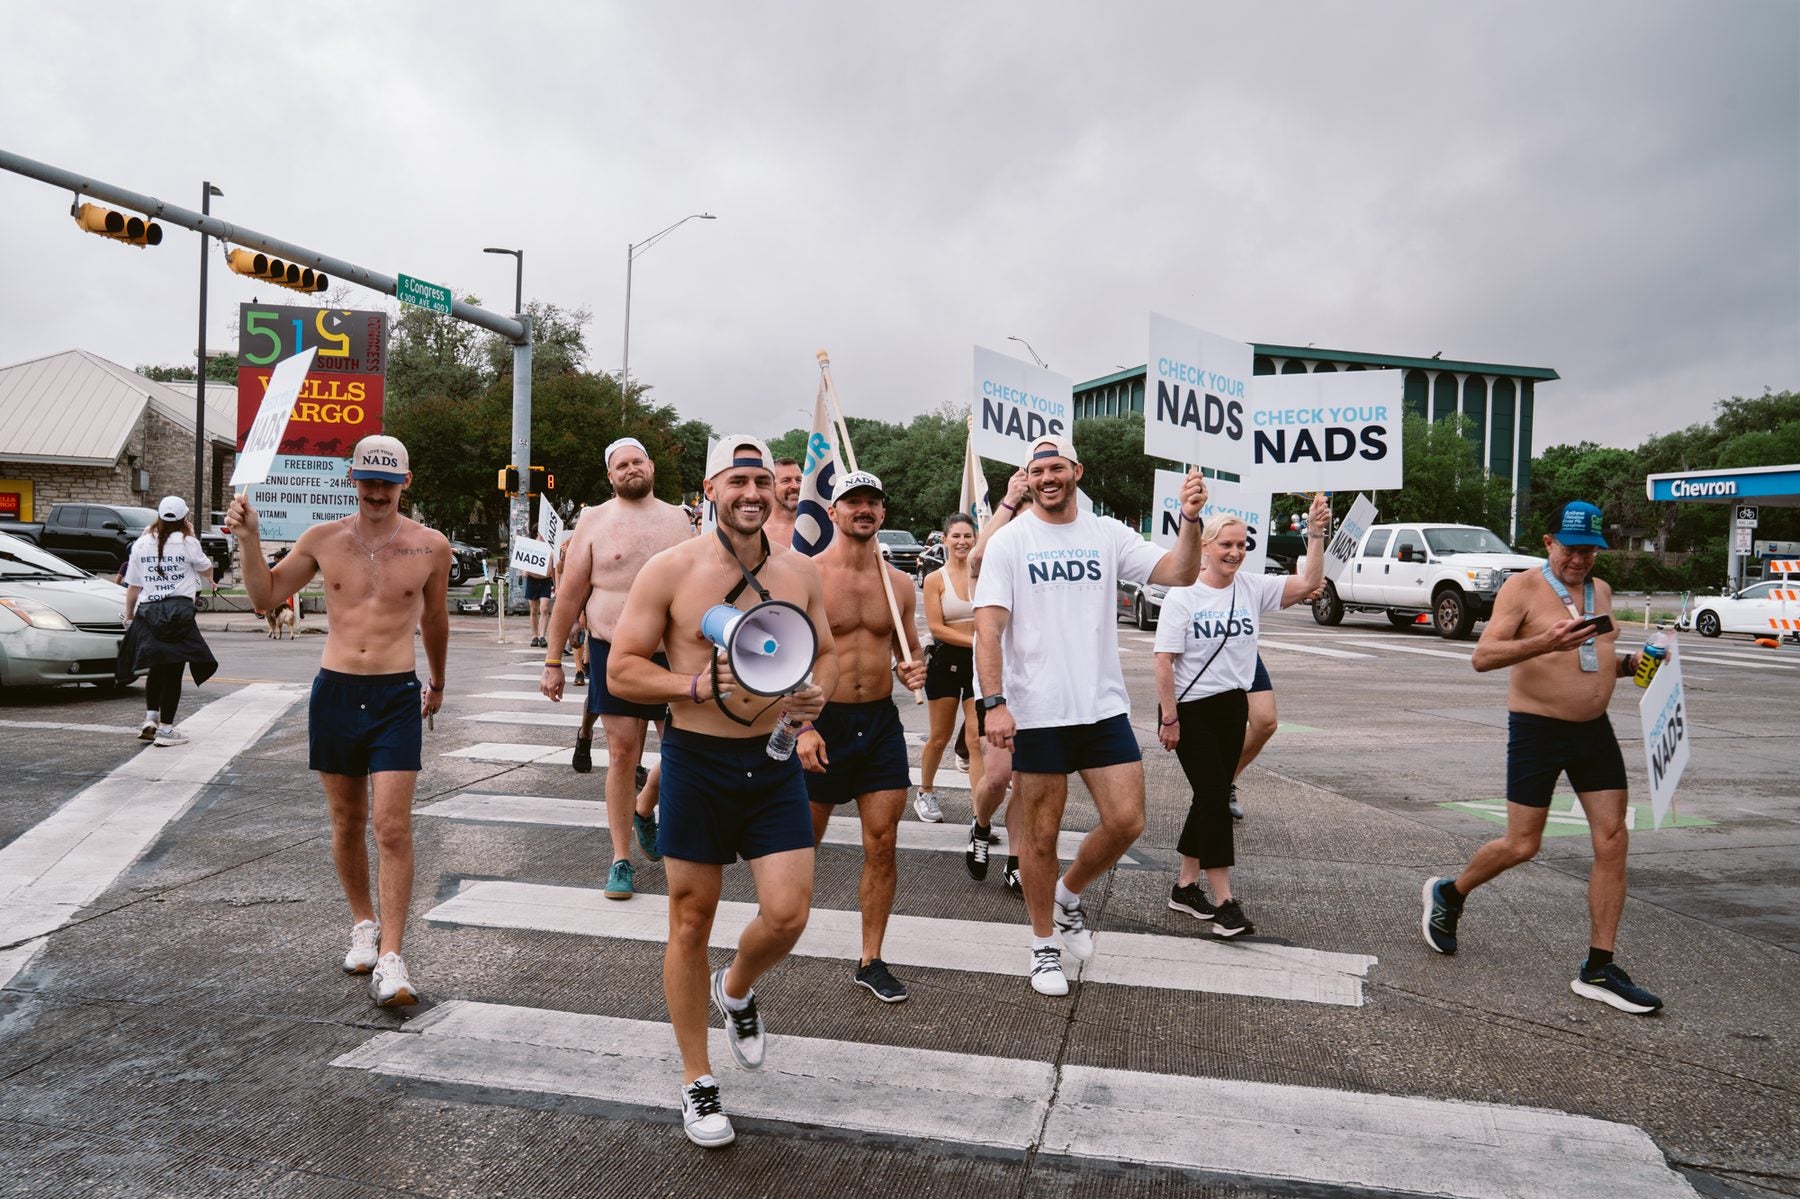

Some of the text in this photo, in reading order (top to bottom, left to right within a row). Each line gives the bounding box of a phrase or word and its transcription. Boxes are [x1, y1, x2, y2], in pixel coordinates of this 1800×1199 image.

[404, 279, 445, 301] S Congress
[405, 293, 444, 312] 300 AVE 400
[316, 356, 359, 370] SOUTH
[1158, 357, 1245, 399] CHECK YOUR
[983, 380, 1065, 418] CHECK YOUR
[1157, 380, 1244, 441] NADS
[1253, 405, 1388, 426] CHECK YOUR
[1253, 425, 1388, 464] NADS
[284, 459, 334, 471] FREEBIRDS
[362, 455, 397, 467] NADS
[260, 475, 288, 486] ENNU
[290, 476, 321, 487] COFFEE
[547, 474, 555, 489] 8
[845, 477, 877, 487] NADS
[1671, 480, 1737, 497] Chevron
[255, 491, 359, 506] HIGH POINT DENTISTRY
[547, 511, 558, 550] NADS
[1162, 510, 1258, 551] NS
[1026, 549, 1100, 561] CHECK YOUR
[1329, 530, 1357, 563] NADS
[515, 550, 546, 567] NADS
[144, 574, 169, 582] THAN
[1028, 560, 1102, 584] NADS
[1194, 610, 1225, 620] CHECK
[1193, 618, 1254, 639] NADS
[1652, 703, 1684, 790] NADS
